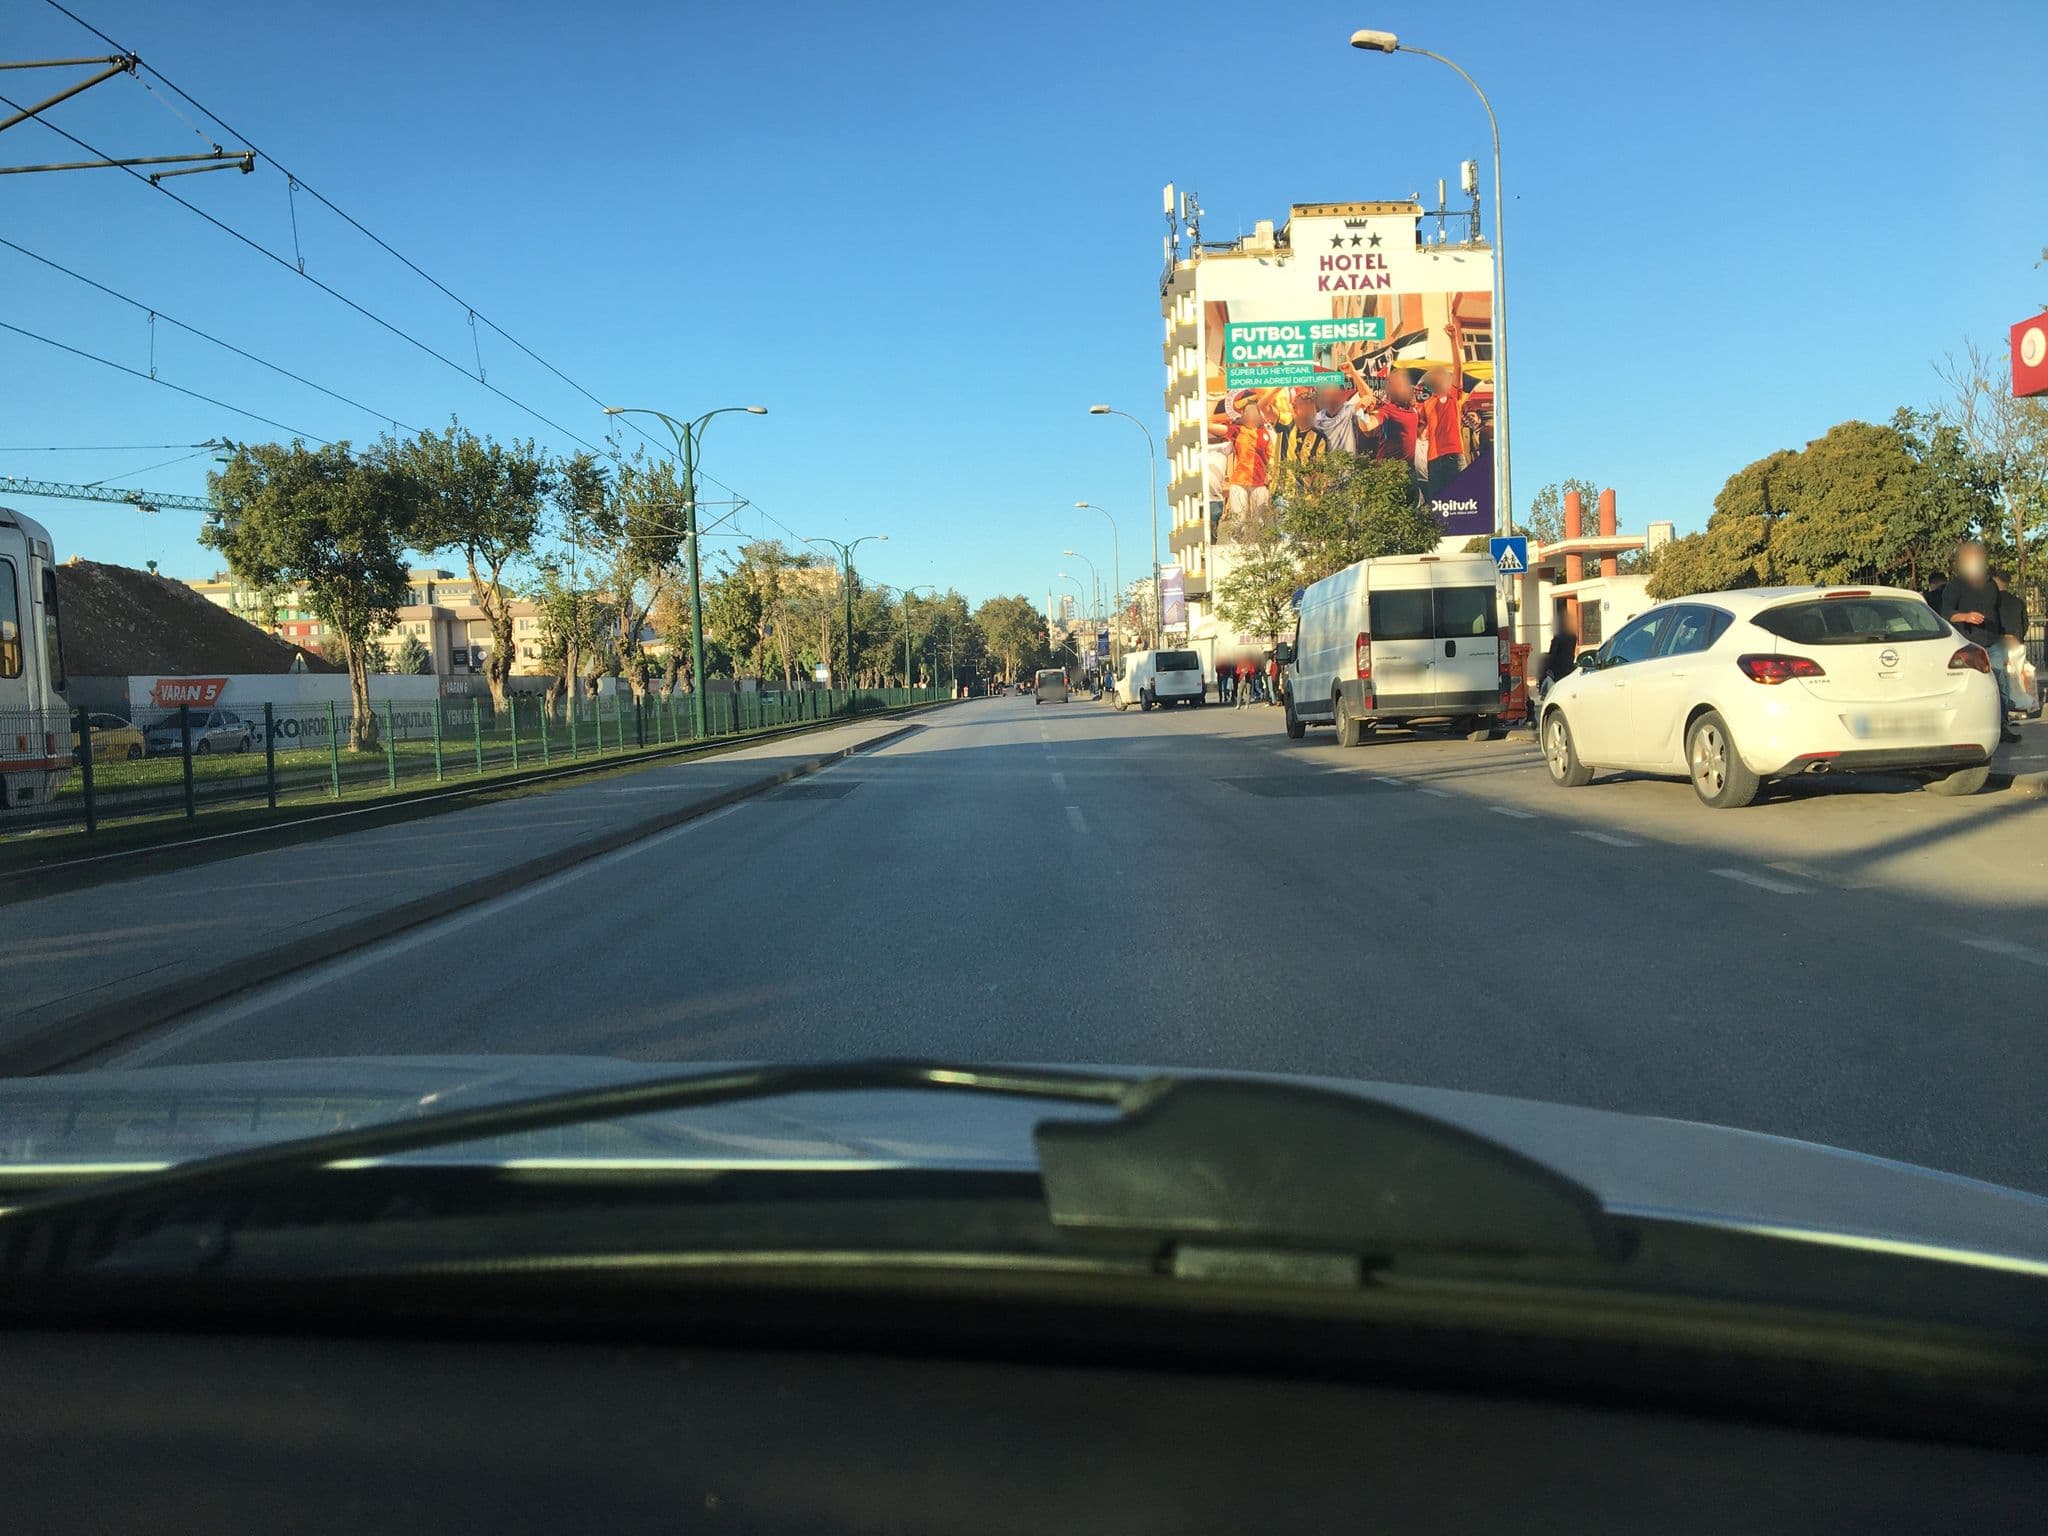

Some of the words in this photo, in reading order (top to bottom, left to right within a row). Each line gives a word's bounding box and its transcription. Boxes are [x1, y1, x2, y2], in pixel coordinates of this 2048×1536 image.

[1320, 253, 1388, 272] HOTEL
[1318, 272, 1391, 292] KATAN
[1231, 326, 1306, 343] FUTBOL
[1310, 319, 1377, 340] SENSİZ
[1231, 343, 1305, 361] OLMAZ!
[1230, 367, 1256, 377] SÜPER
[1258, 365, 1269, 376] LİG
[1230, 377, 1262, 387] SPORUN
[1263, 375, 1293, 386] ADRESİ
[1431, 498, 1478, 517] Digiturk
[161, 685, 202, 701] VARAN
[204, 684, 217, 700] 5
